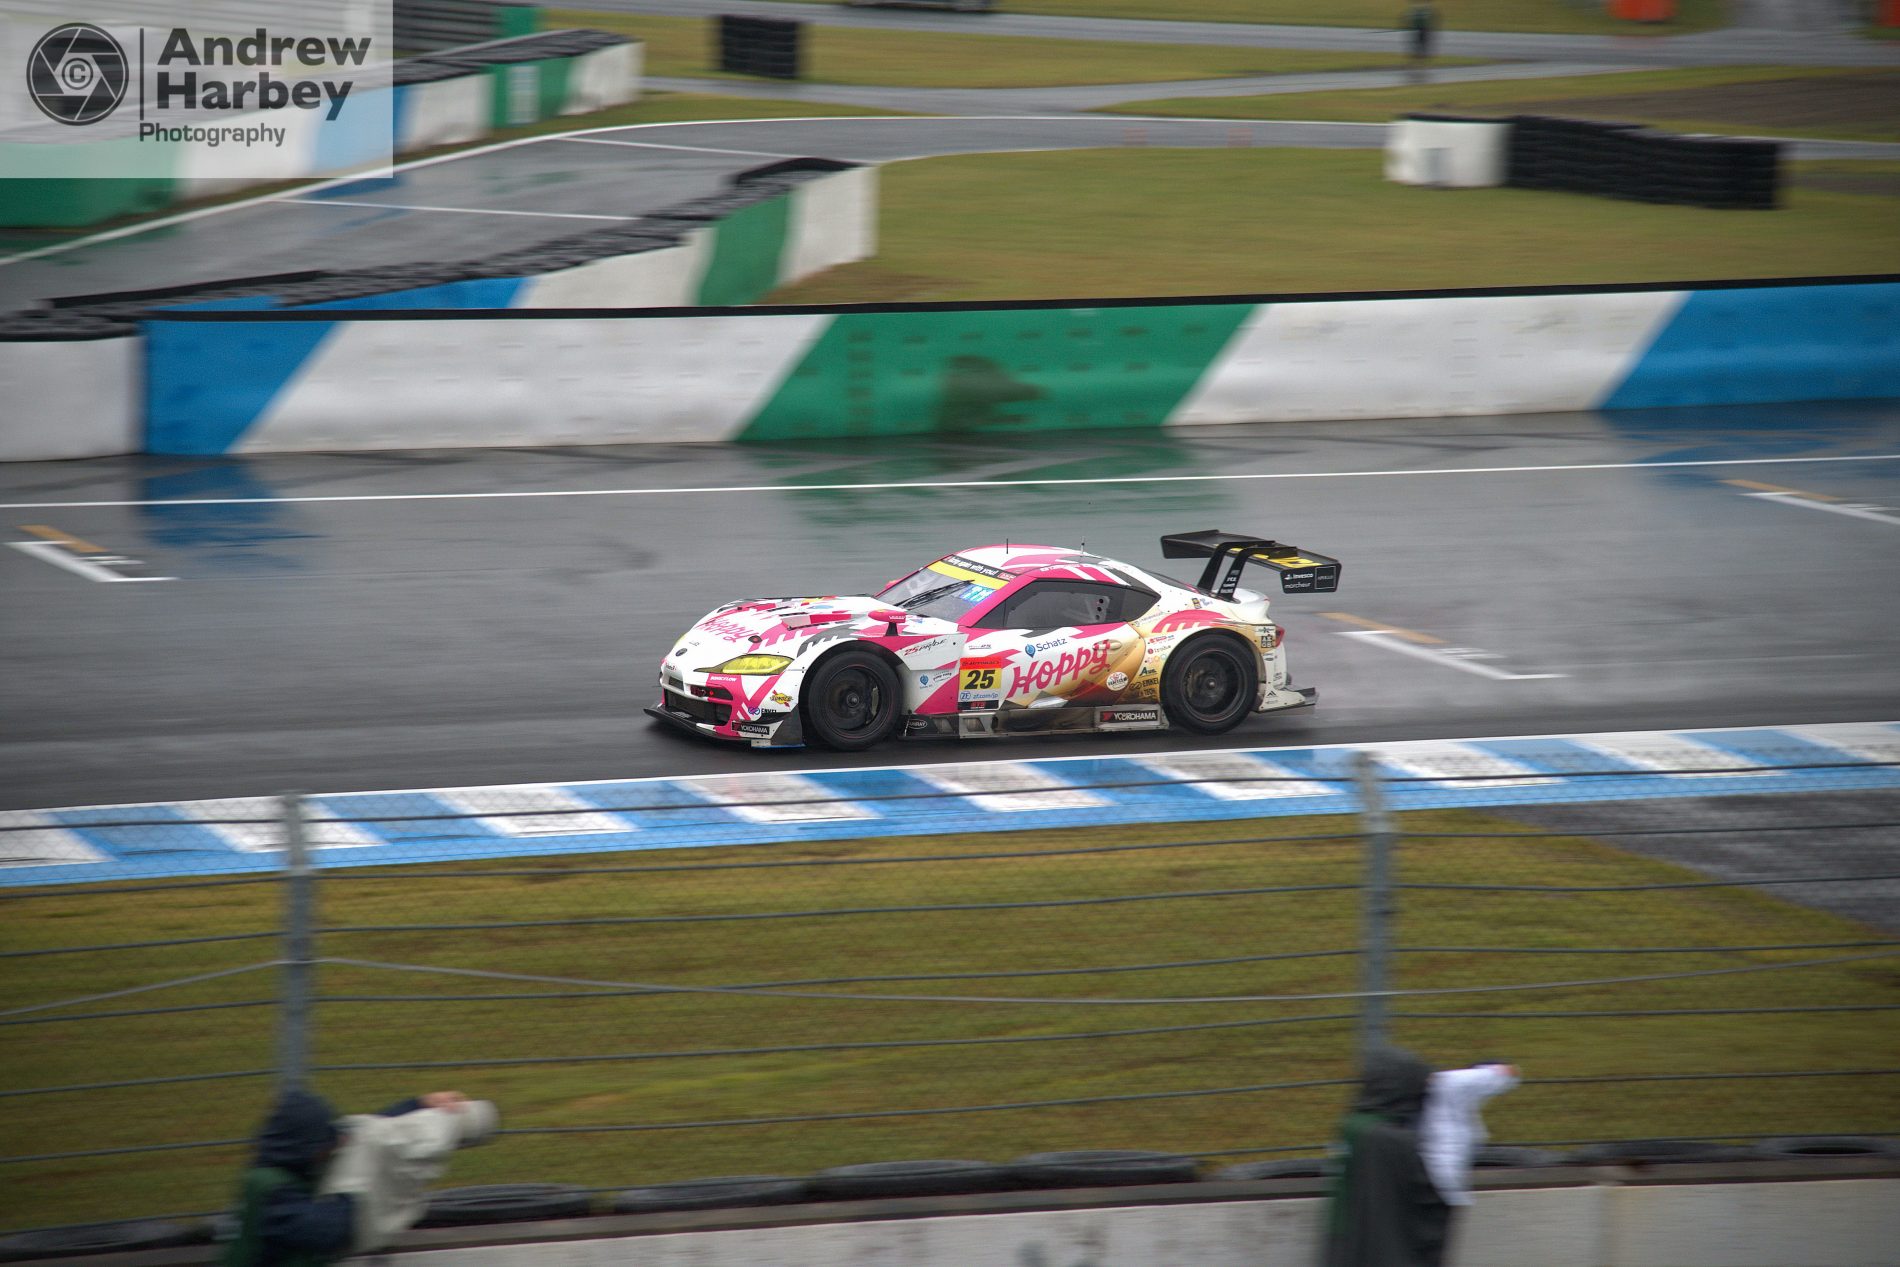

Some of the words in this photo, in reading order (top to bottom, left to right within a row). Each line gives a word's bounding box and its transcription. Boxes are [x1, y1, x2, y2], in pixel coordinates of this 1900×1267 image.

[1036, 637, 1068, 652] Schatz
[1005, 640, 1110, 699] Hoppy
[964, 669, 995, 690] 25
[1114, 711, 1157, 721] YOKOHAMA
[741, 724, 768, 734] YOKOHAMA
